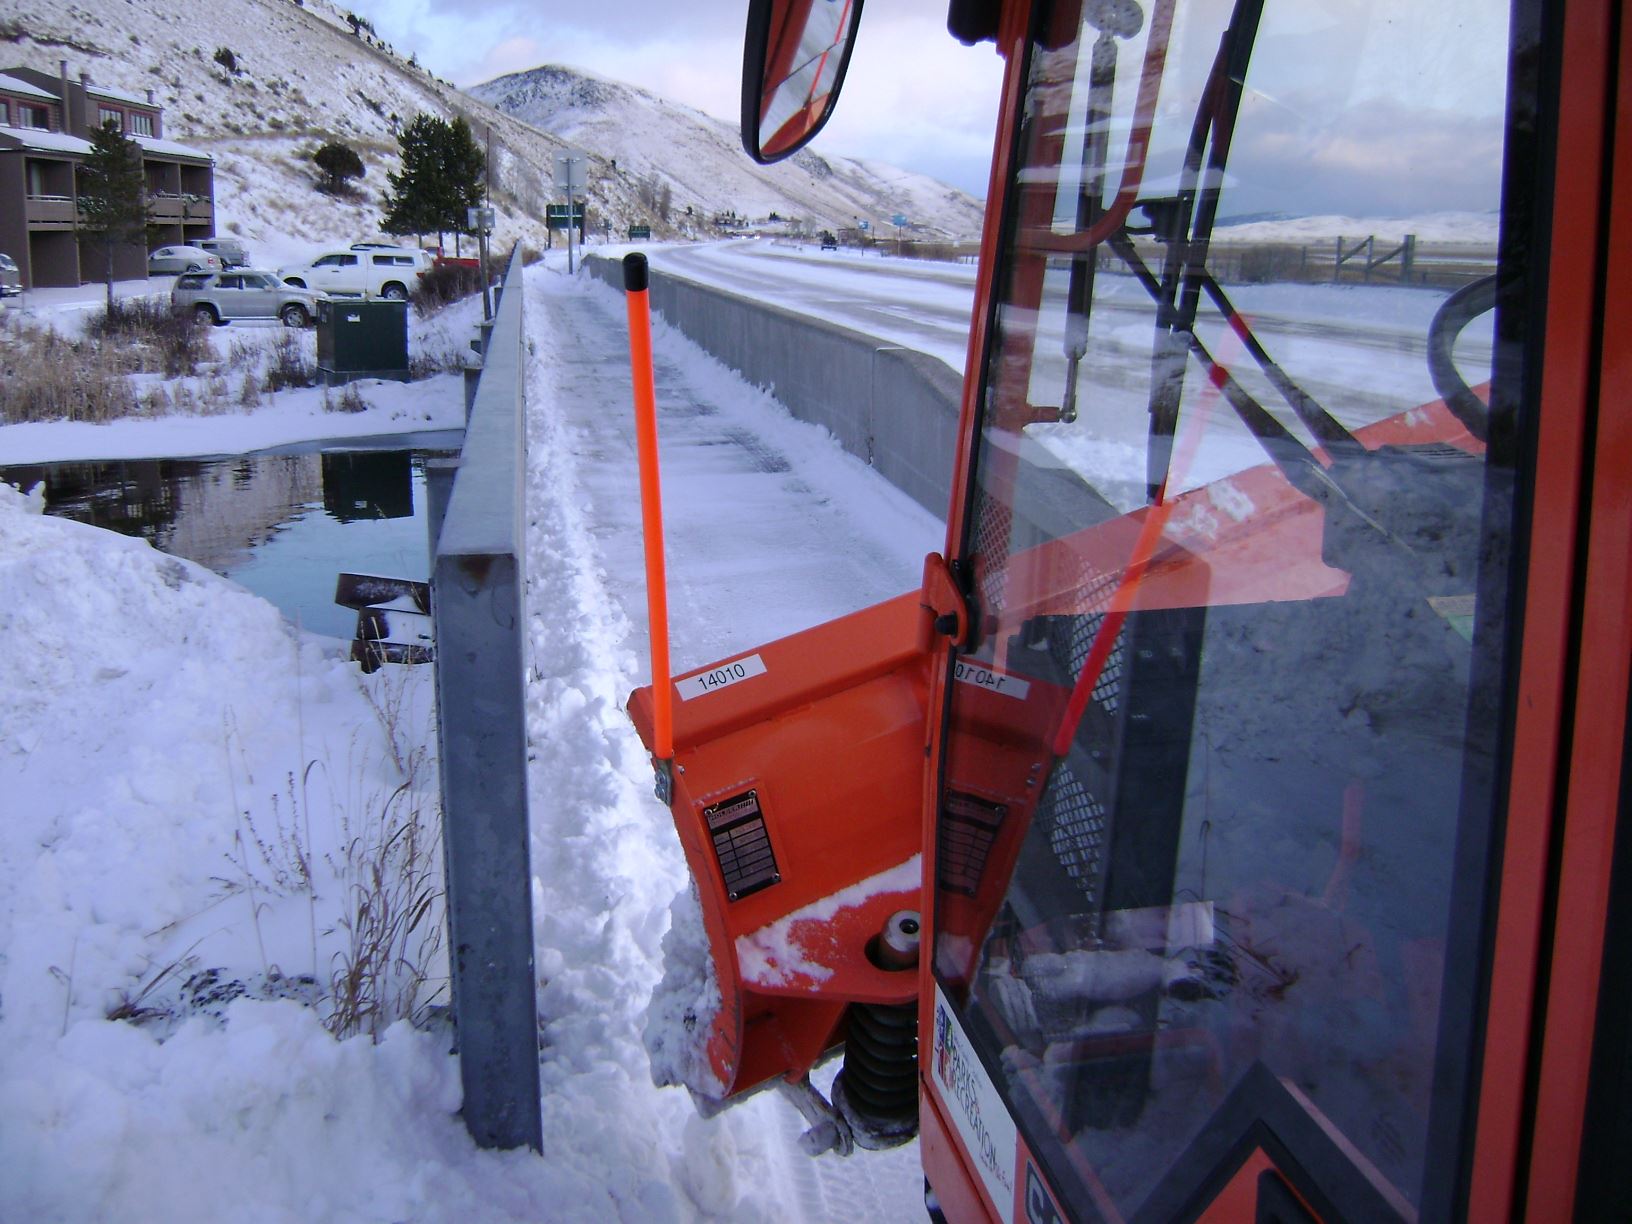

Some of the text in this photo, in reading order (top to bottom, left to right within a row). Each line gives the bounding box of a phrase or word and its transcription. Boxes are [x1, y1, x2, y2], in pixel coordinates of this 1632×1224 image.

[698, 664, 745, 690] 14010
[952, 1043, 977, 1104] PARKS
[952, 1070, 997, 1166] RECREATION
